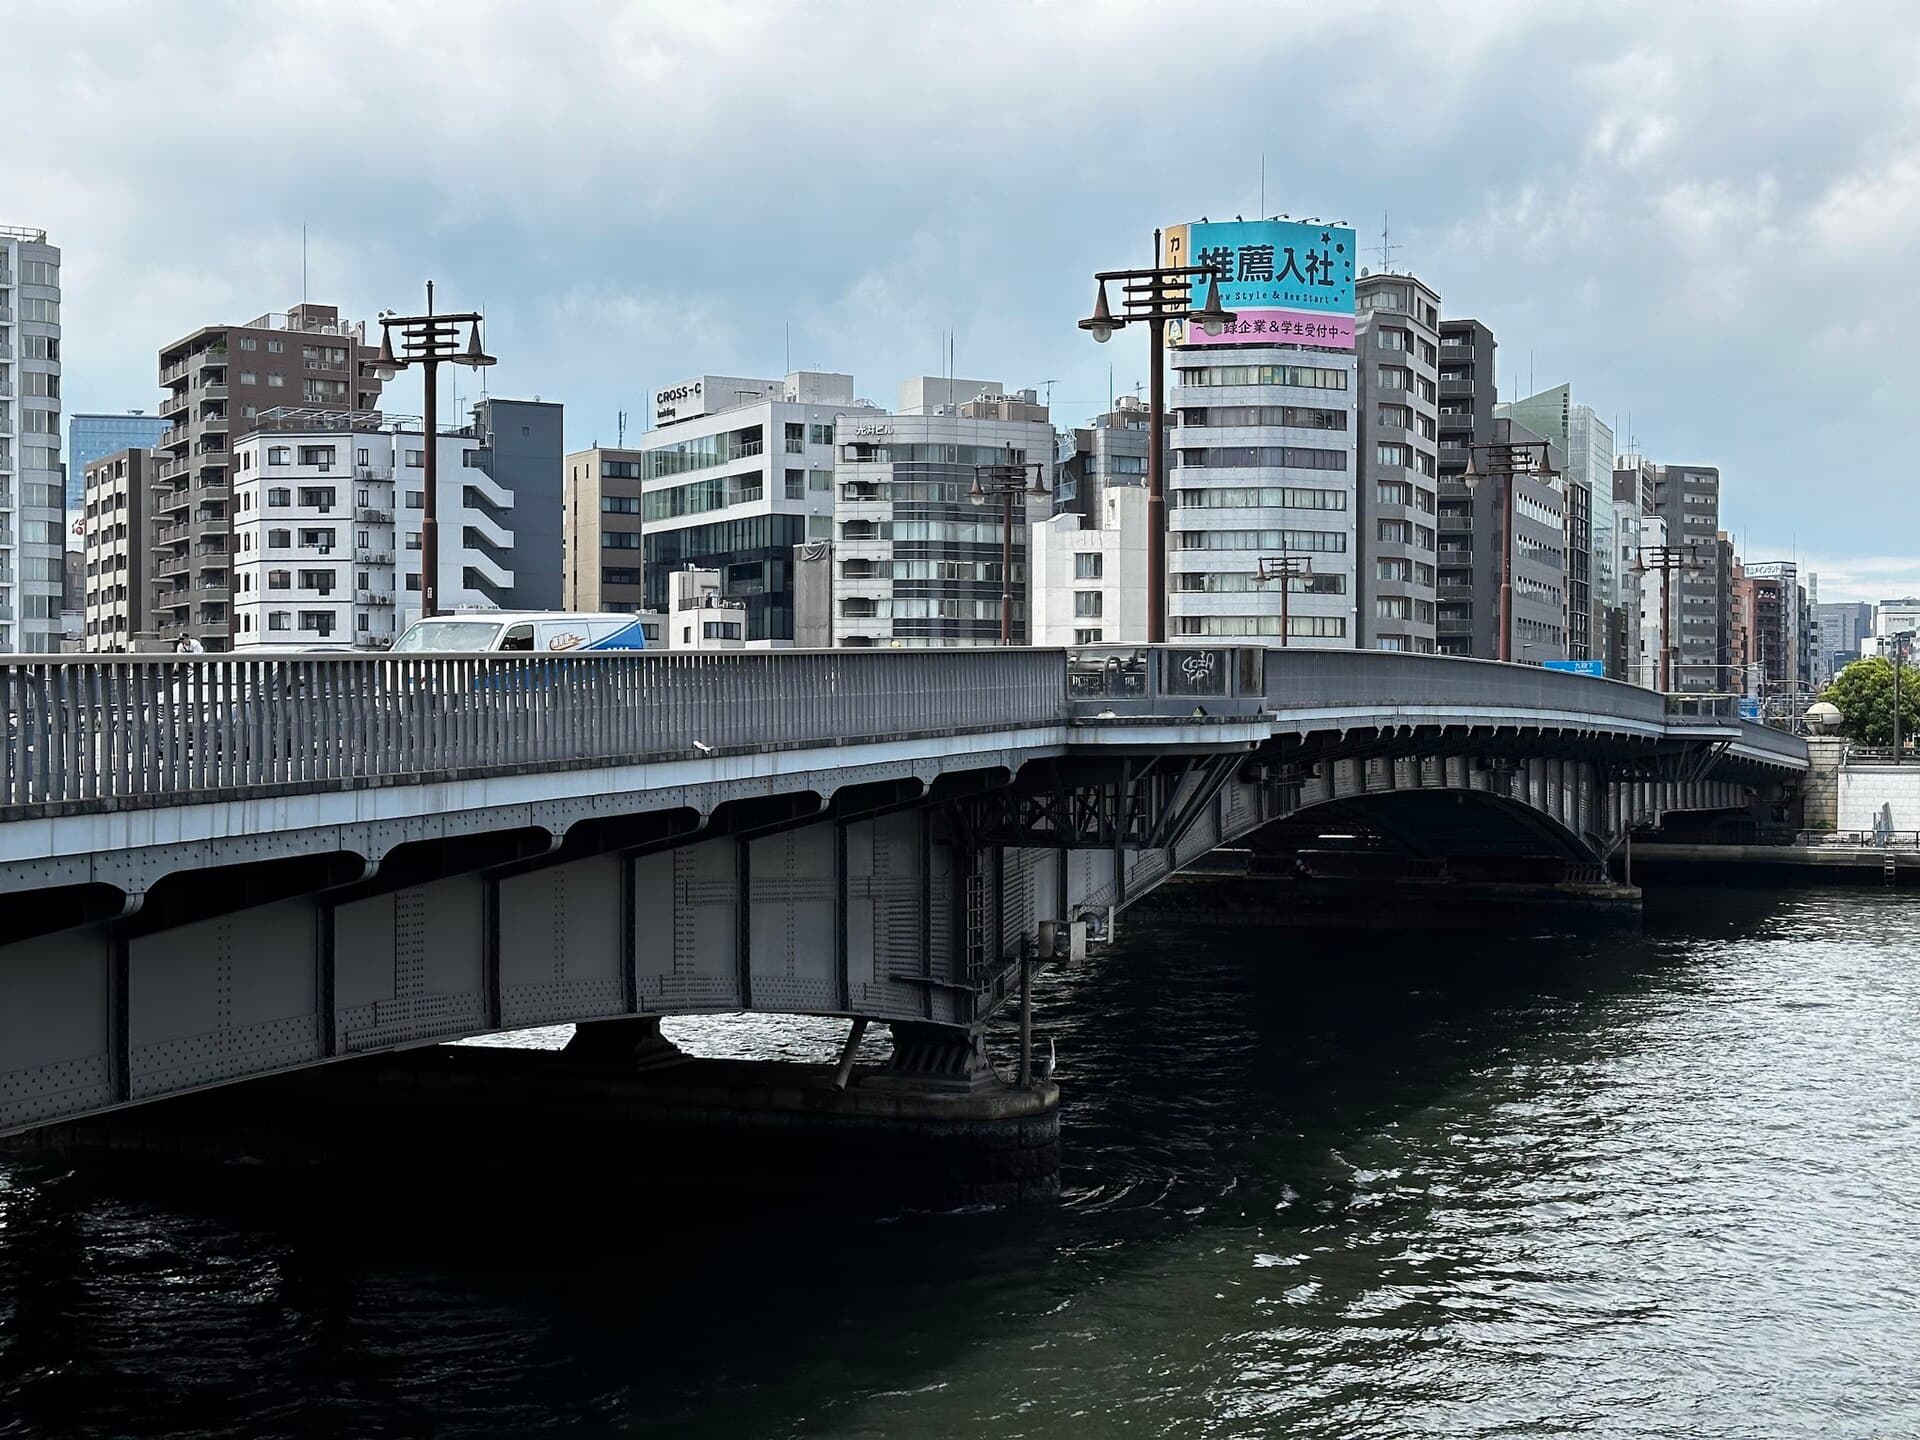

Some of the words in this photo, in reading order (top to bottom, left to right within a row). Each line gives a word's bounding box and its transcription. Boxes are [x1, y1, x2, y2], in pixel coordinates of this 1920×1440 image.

[1198, 245, 1334, 286] 推薦入社
[1235, 291, 1268, 301] Style
[1272, 290, 1280, 300] &
[1303, 293, 1330, 304] Start
[657, 382, 702, 404] CROSS-C
